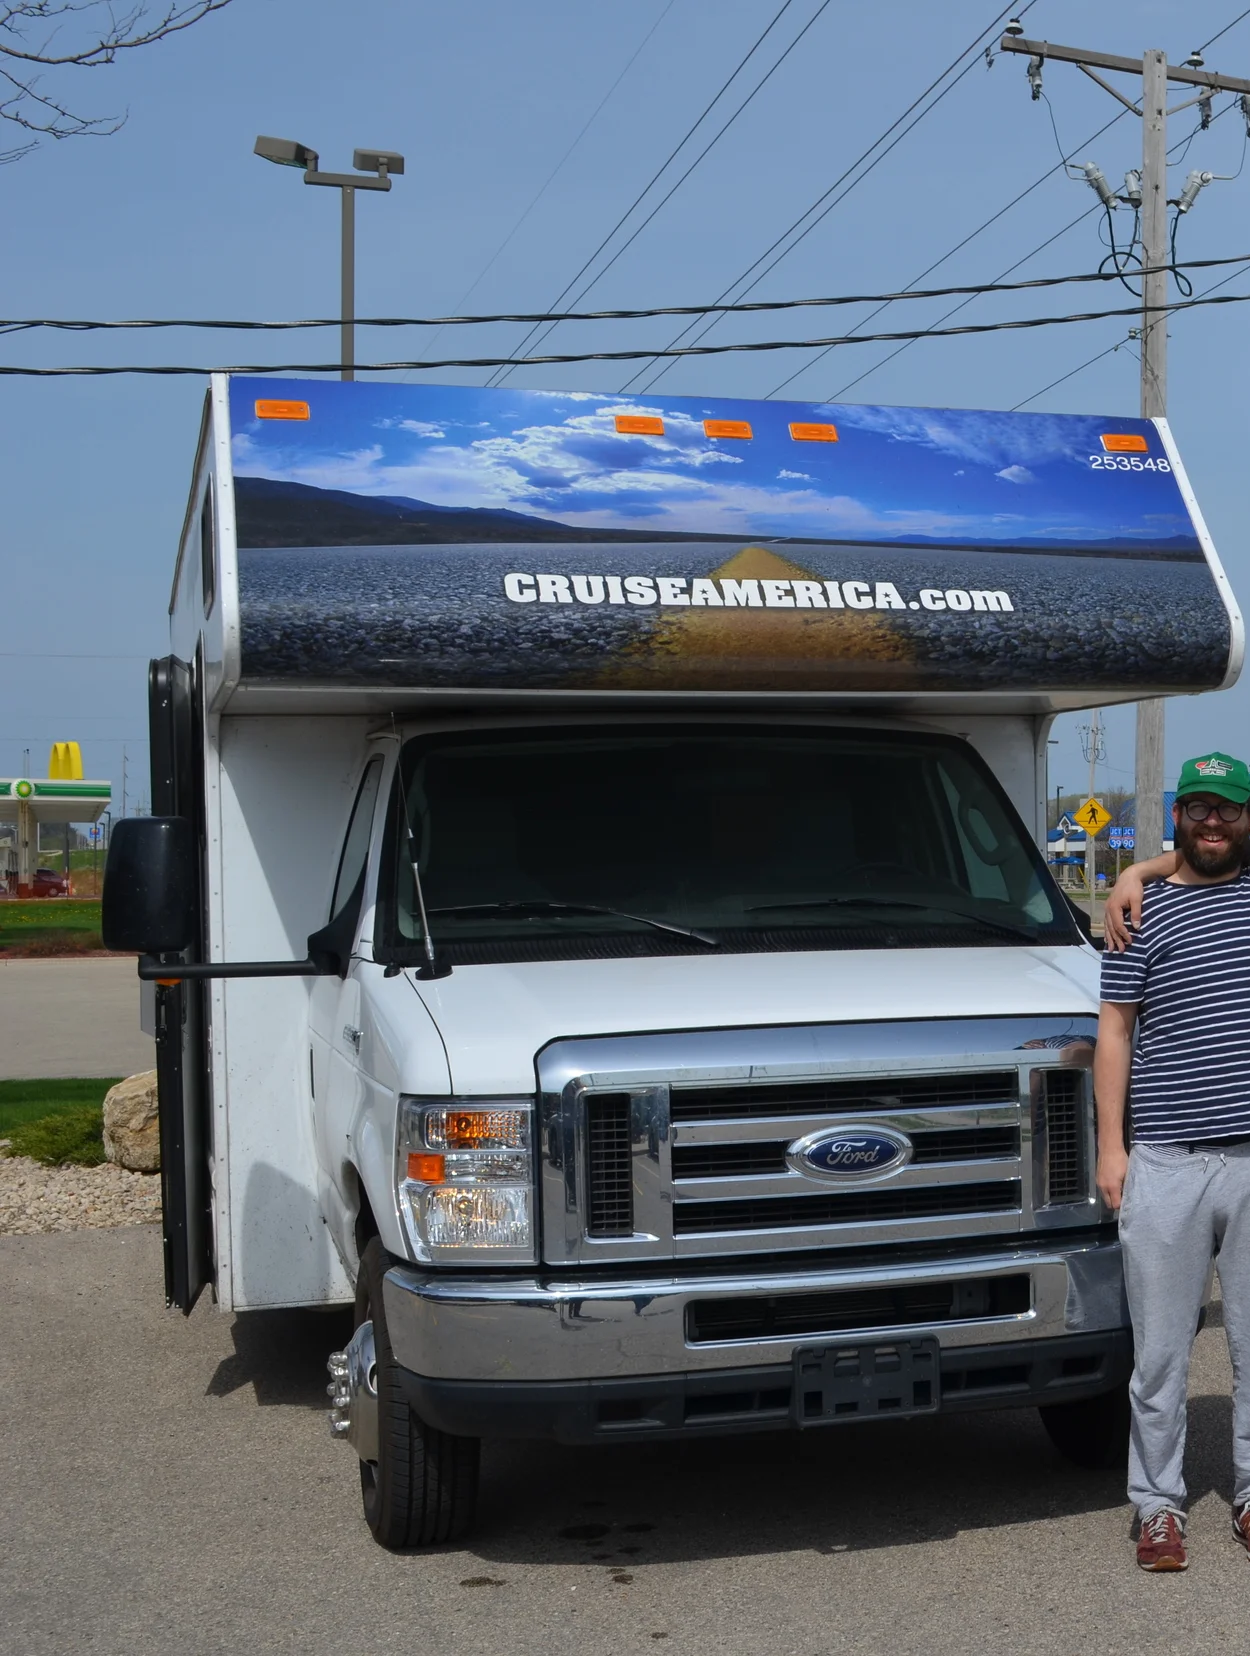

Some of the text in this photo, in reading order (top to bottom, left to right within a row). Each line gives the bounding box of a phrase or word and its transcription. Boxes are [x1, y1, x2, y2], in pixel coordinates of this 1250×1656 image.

[1089, 455, 1171, 472] 253548
[503, 572, 1014, 612] CRUISEAMERICA.com
[1111, 839, 1121, 848] 39
[1124, 839, 1134, 847] 90
[826, 1141, 880, 1165] Ford
